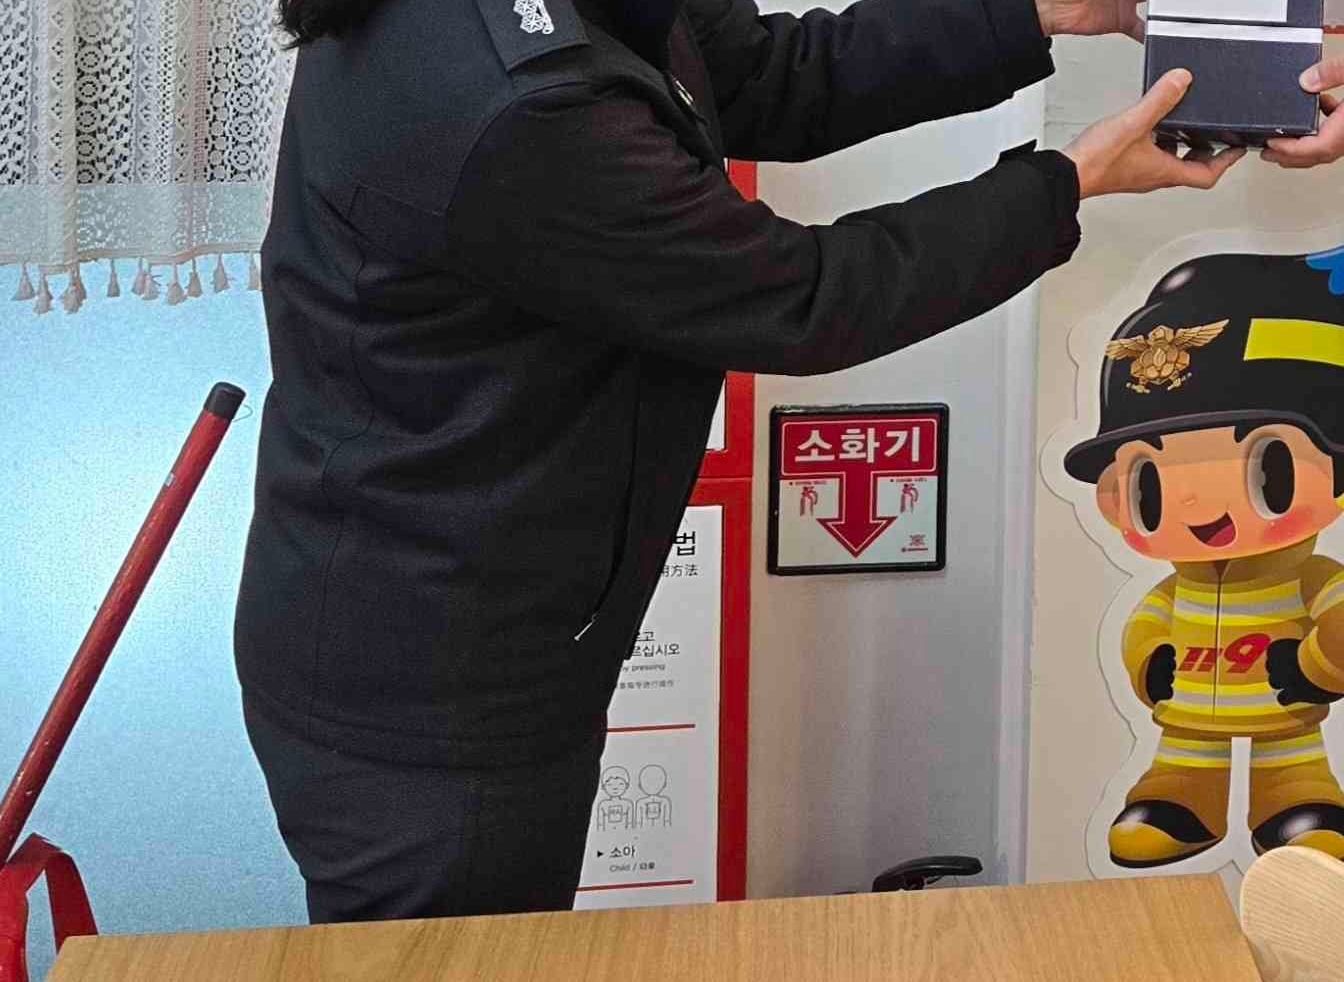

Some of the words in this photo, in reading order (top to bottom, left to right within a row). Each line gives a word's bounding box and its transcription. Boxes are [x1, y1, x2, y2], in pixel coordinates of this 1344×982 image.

[794, 426, 921, 464] 소화기
[1178, 632, 1271, 673] 119
[609, 845, 635, 858] 소아
